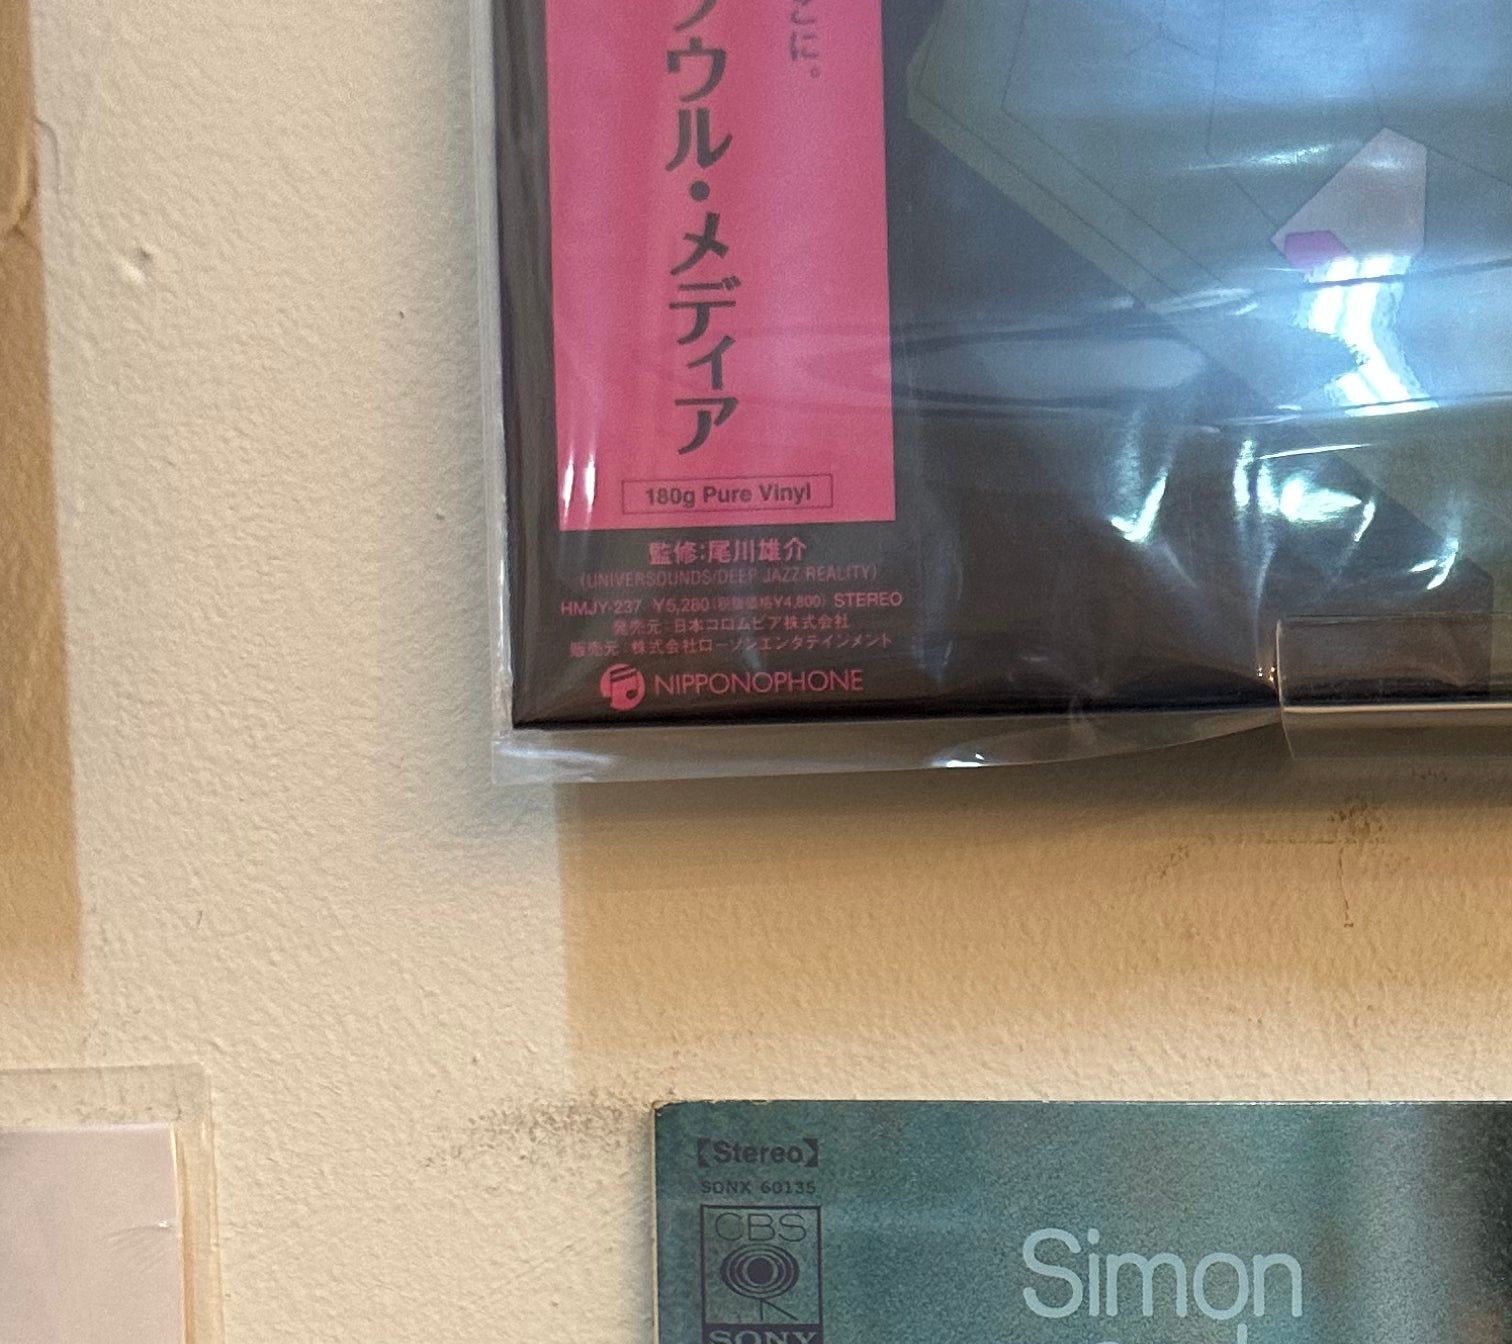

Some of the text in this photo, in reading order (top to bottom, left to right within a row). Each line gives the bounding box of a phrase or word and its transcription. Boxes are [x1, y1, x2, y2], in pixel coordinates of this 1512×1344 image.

[645, 482, 812, 508] 180g Pure Vinyl
[762, 567, 800, 584] JAZZ
[833, 591, 903, 608] STEREO
[654, 669, 865, 696] NIPPONOPHONE
[714, 1212, 807, 1242] CBS
[1021, 1227, 1303, 1320] Simon
